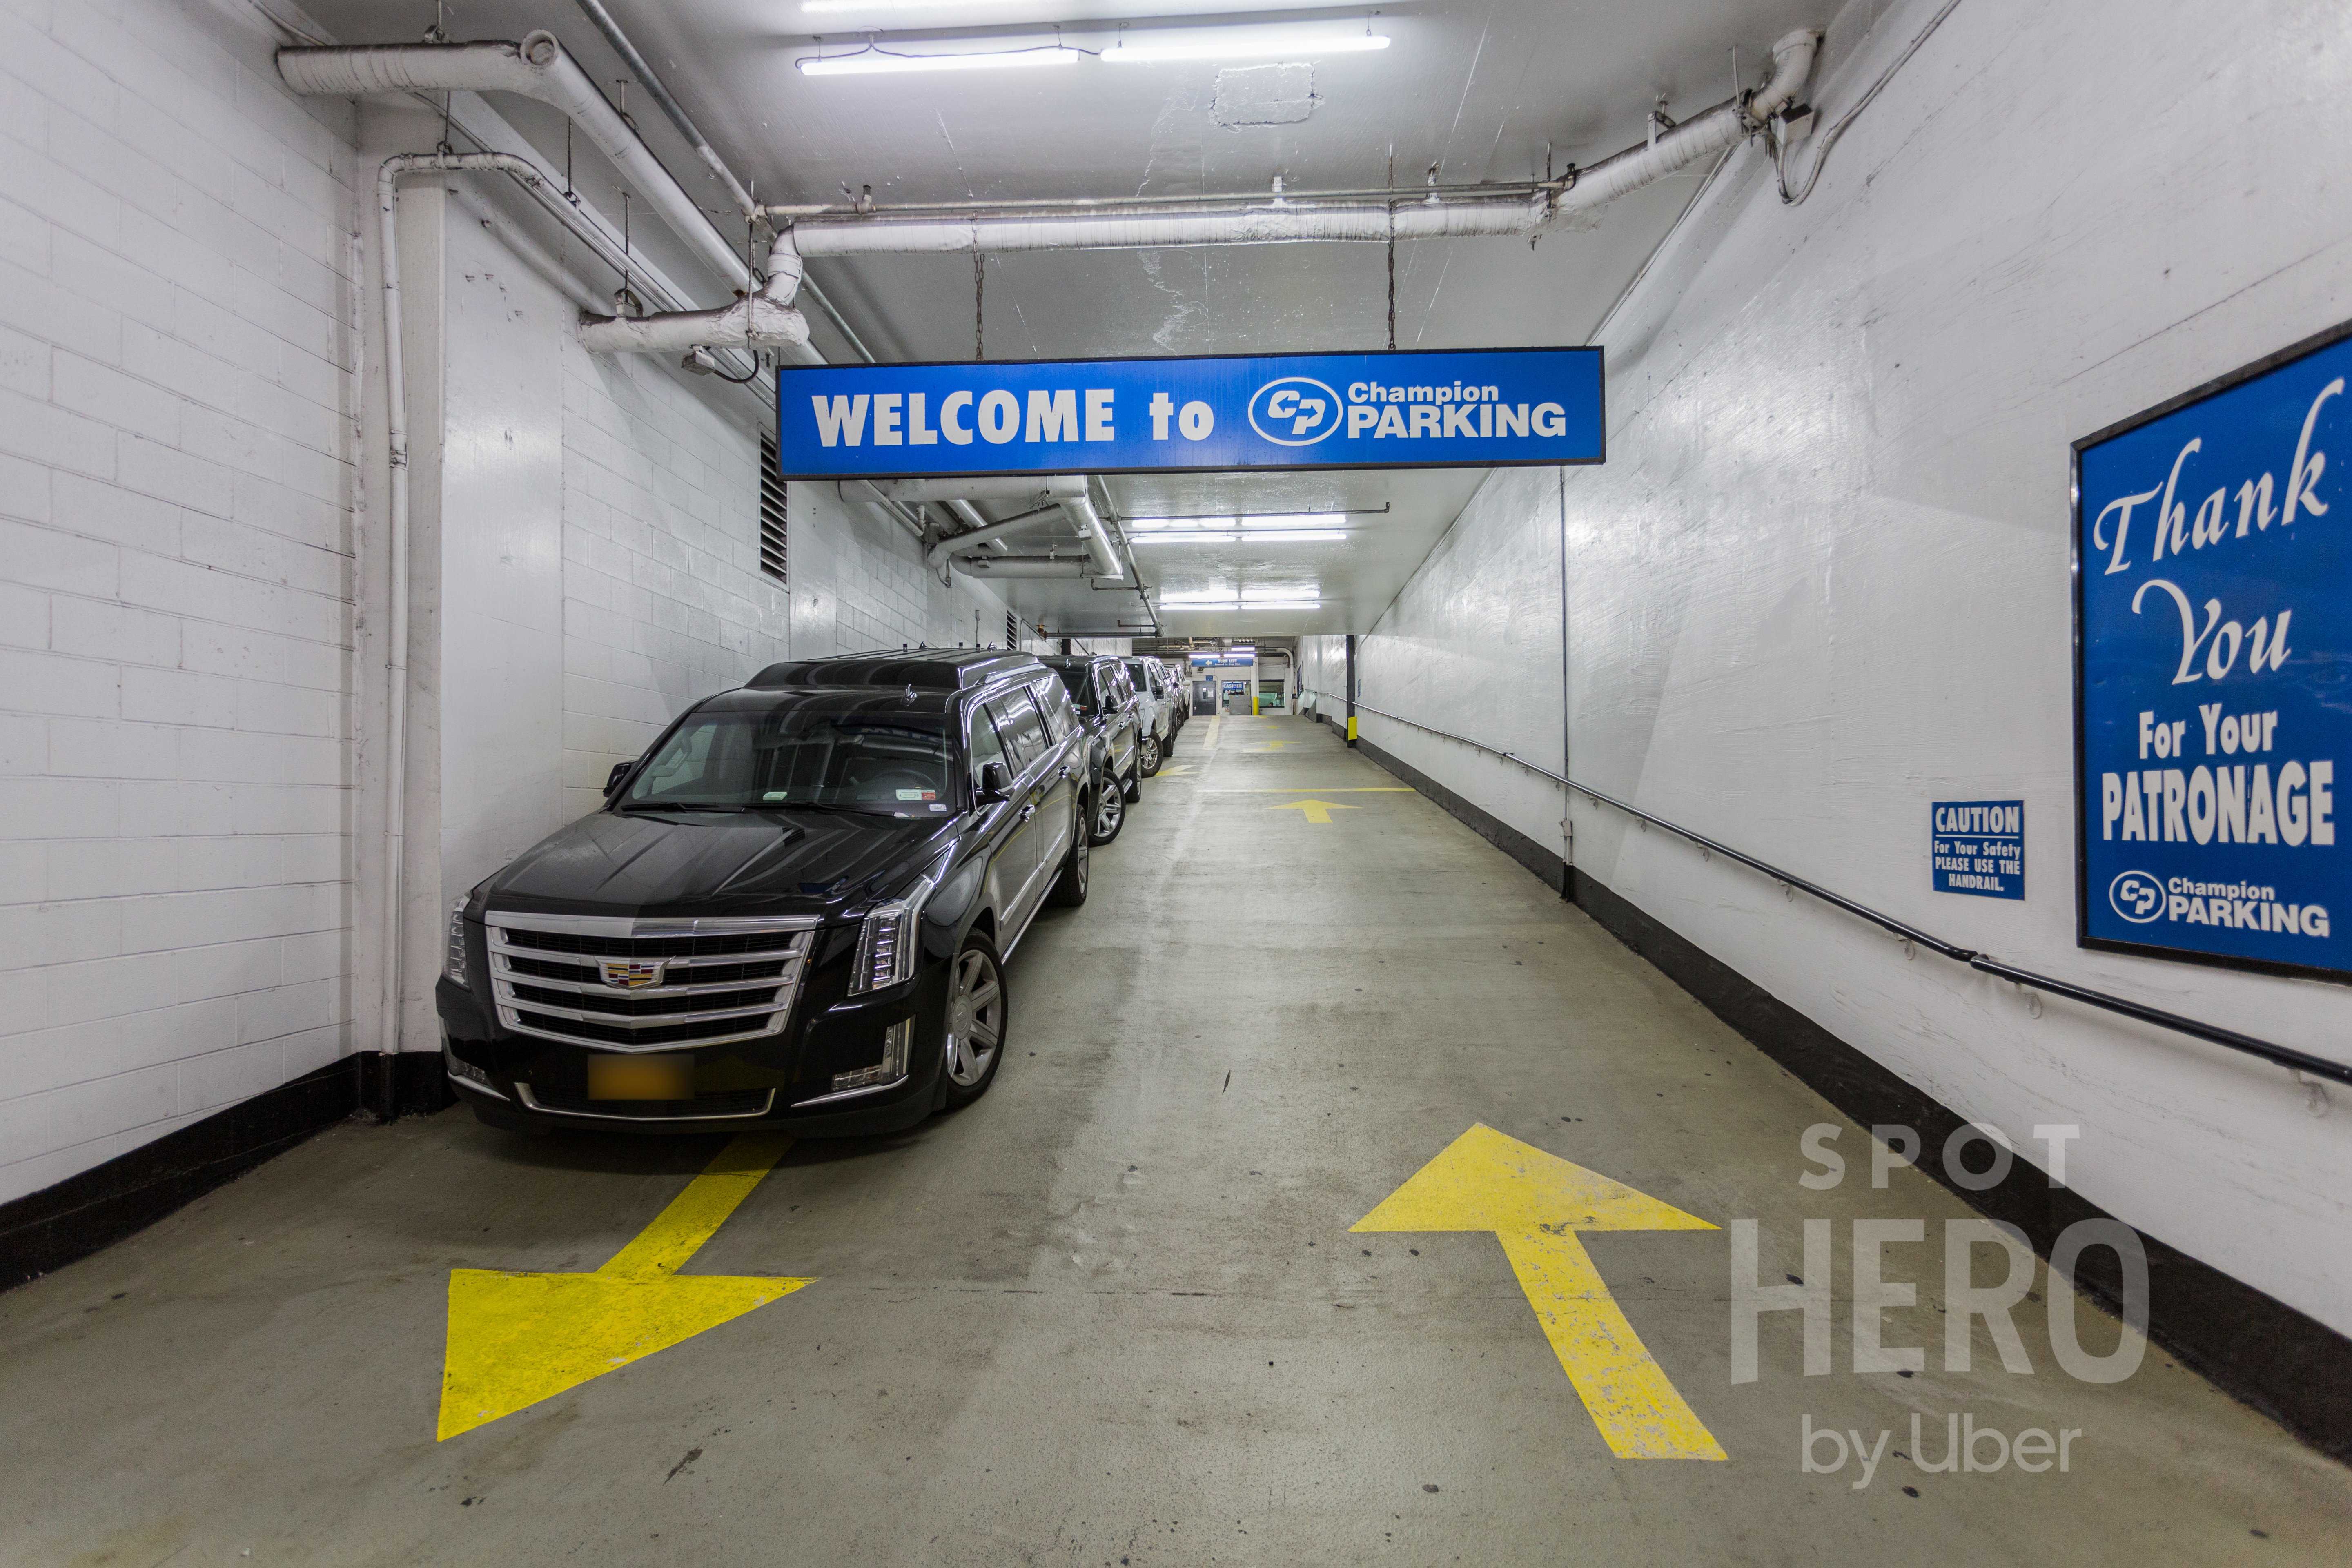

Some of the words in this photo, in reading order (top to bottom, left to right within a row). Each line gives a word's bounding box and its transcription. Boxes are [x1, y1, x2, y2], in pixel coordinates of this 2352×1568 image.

[1348, 381, 1499, 404] Champion
[812, 389, 1114, 447] WELCOME
[1149, 392, 1214, 442] to
[1348, 402, 1566, 439] PARKING
[2094, 378, 2345, 575] Thank
[2132, 579, 2292, 685] You
[2140, 711, 2185, 759] For
[2199, 703, 2278, 755] Your
[1936, 806, 2019, 833] CAUTION
[2103, 760, 2334, 846] PATRONAGE
[1934, 840, 1950, 853] For
[1954, 841, 1978, 855] Your
[1982, 841, 2021, 860] Safety
[1935, 856, 1969, 871] PLEASE
[1974, 858, 1994, 873] USE
[1999, 860, 2020, 875] THE
[1949, 873, 2005, 891] HANDRAIL.
[2168, 878, 2275, 900] Champion
[2169, 895, 2330, 937] PARKING
